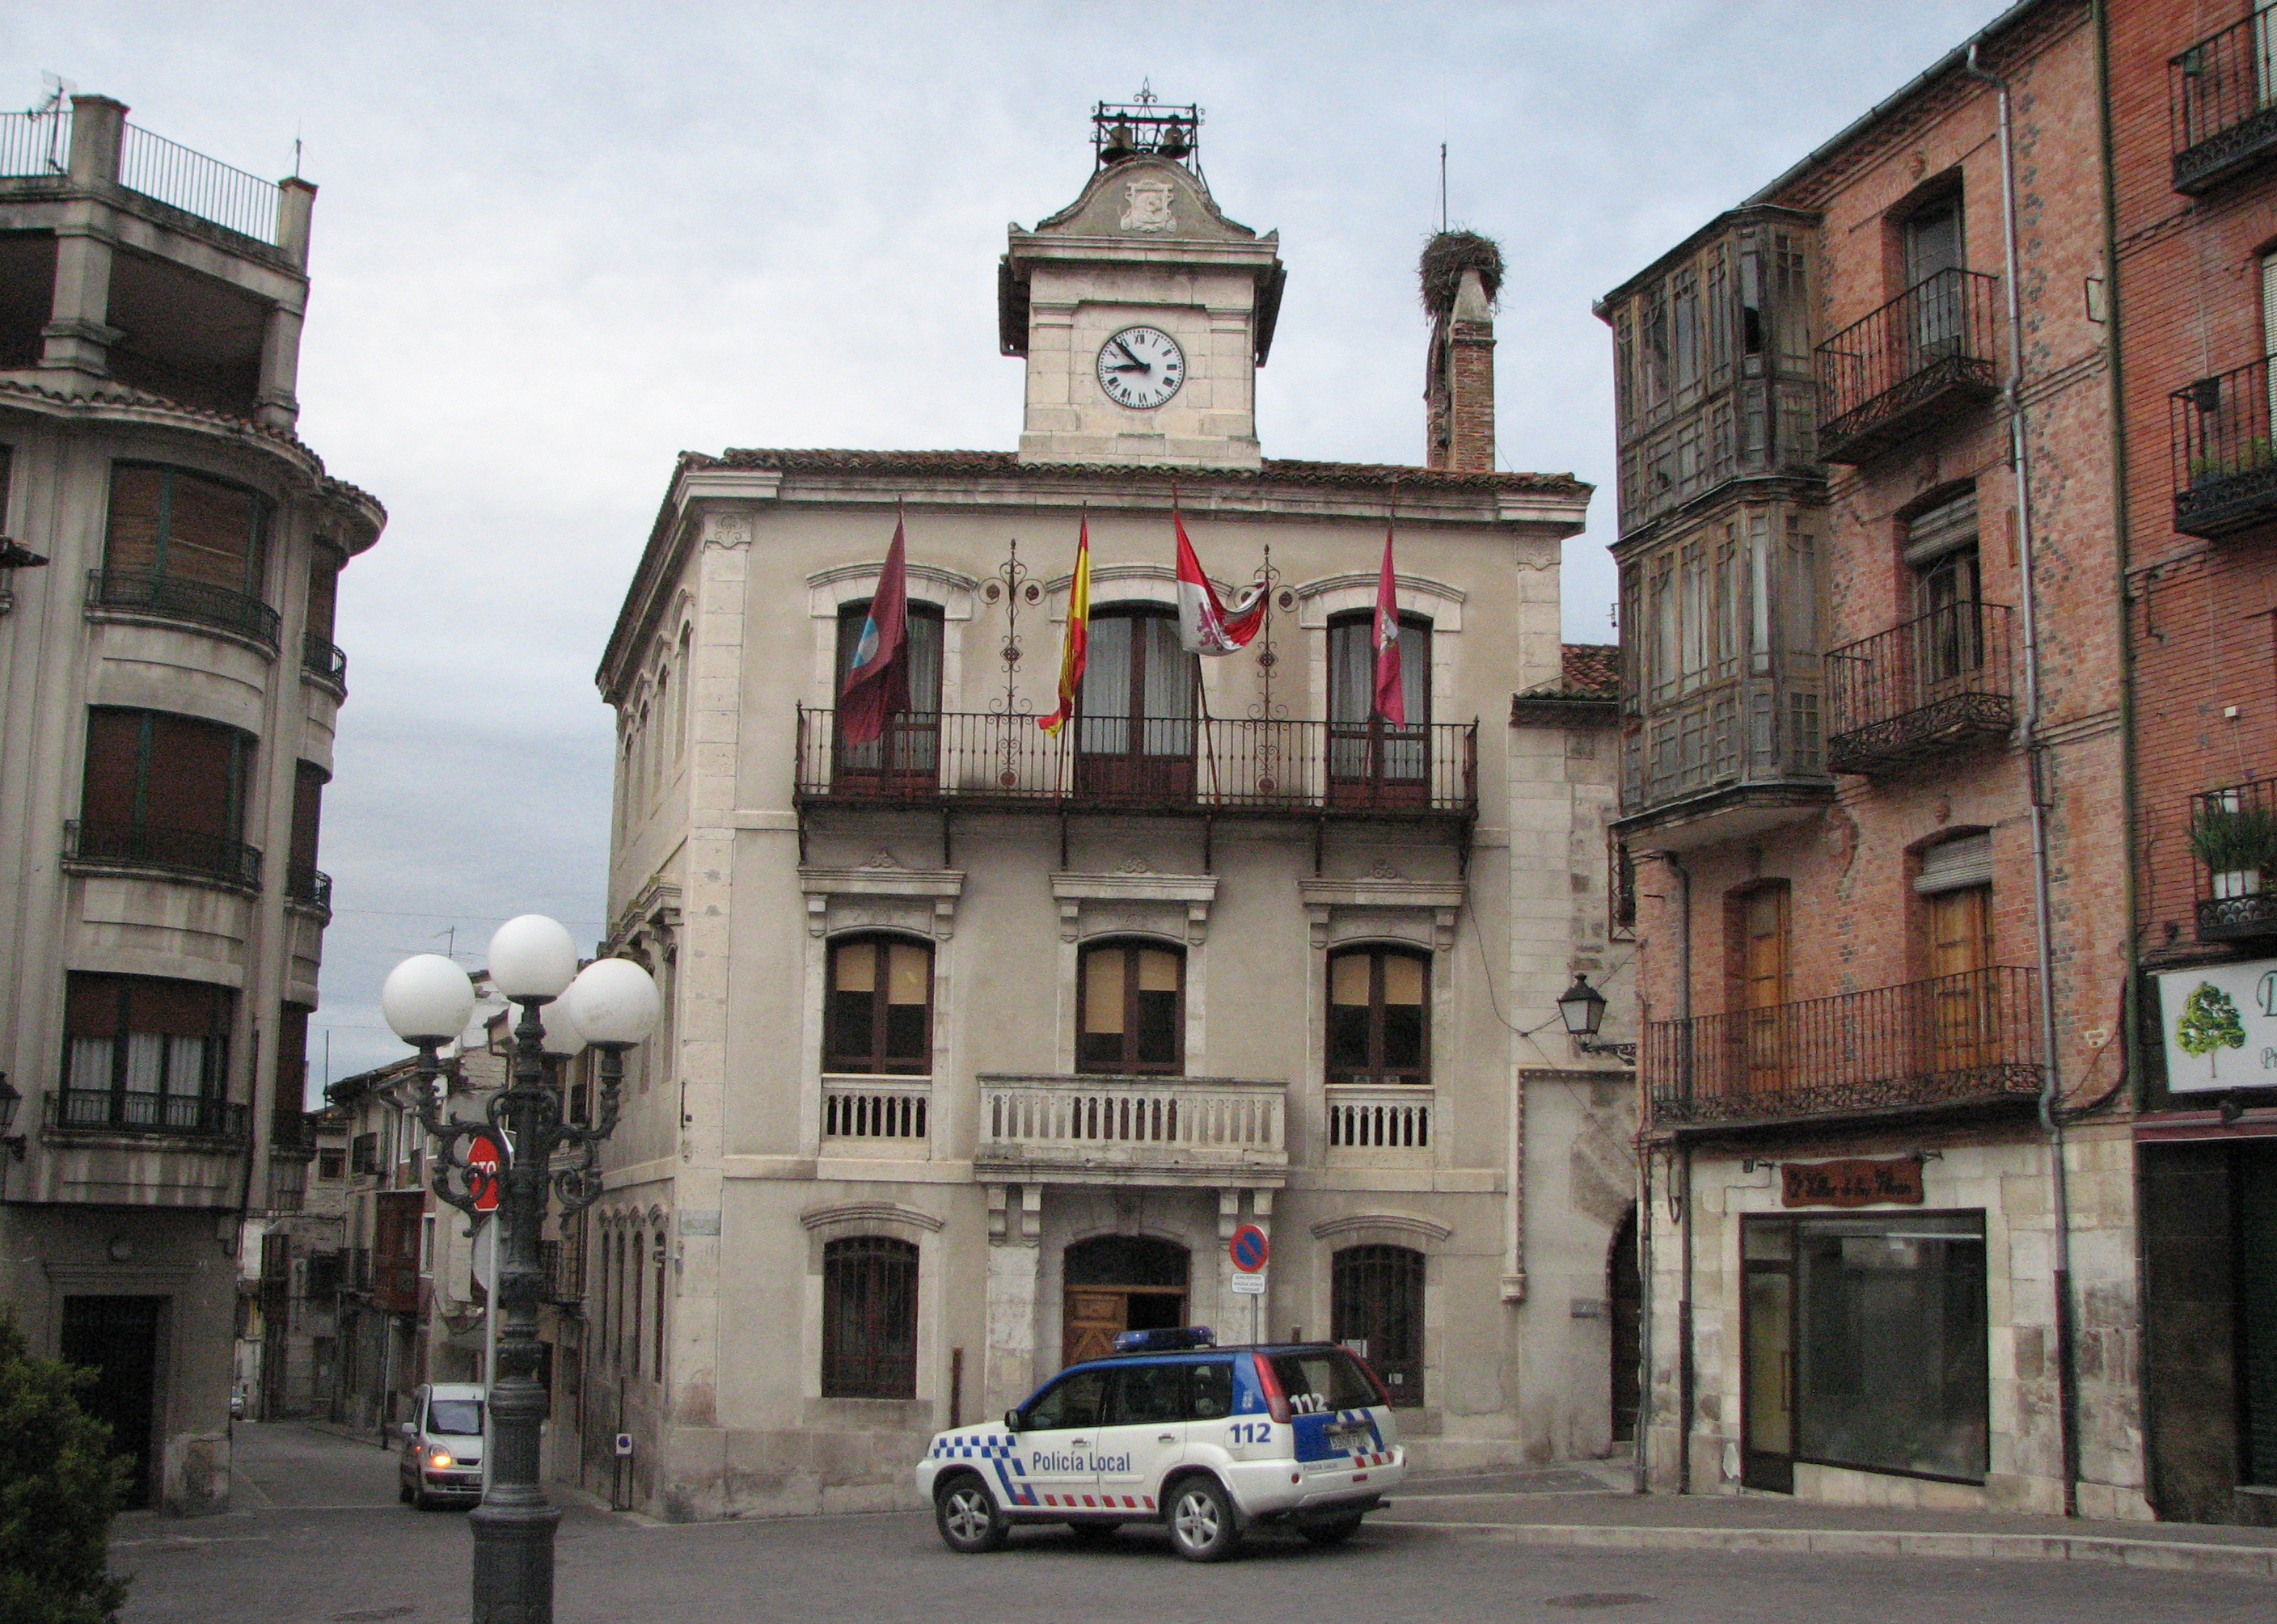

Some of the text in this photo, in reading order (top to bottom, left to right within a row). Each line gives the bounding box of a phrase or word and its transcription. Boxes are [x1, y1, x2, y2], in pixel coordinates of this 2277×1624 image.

[1289, 1392, 1328, 1414] 112
[1229, 1422, 1271, 1444] 112
[1033, 1450, 1130, 1471] Policía Local
